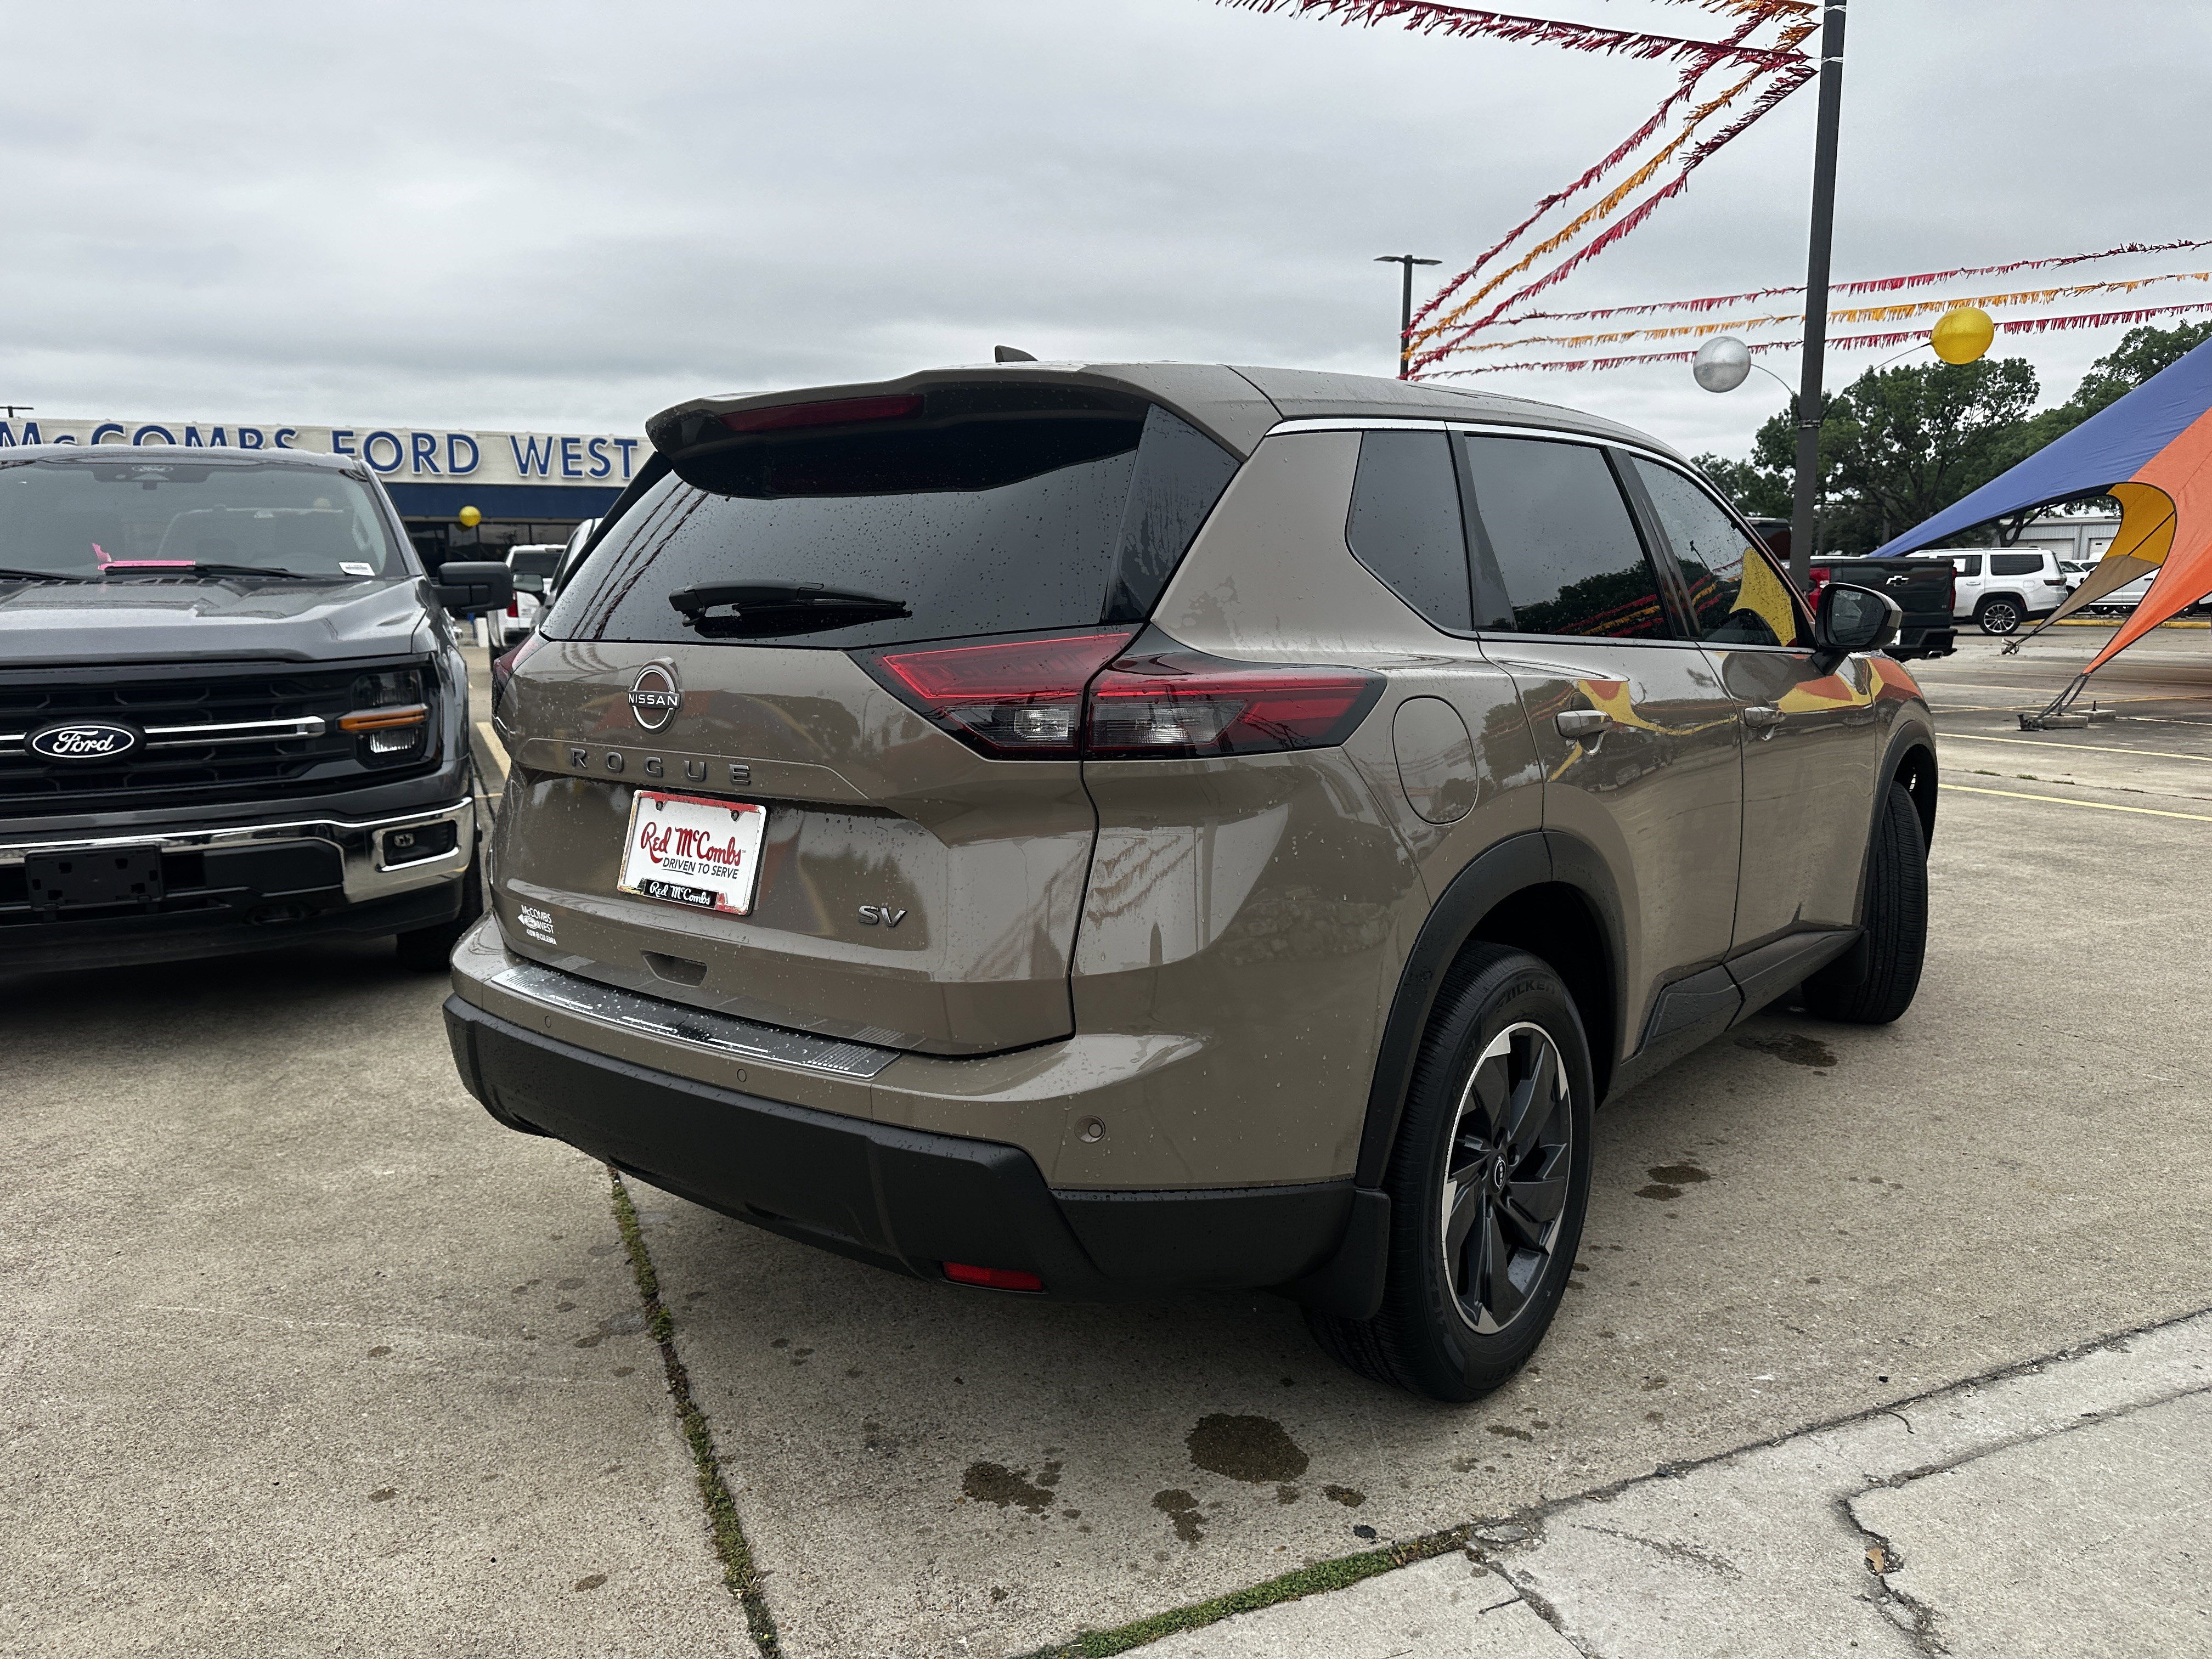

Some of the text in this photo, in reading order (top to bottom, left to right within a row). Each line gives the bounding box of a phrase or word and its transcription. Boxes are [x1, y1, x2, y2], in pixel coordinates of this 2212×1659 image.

[332, 431, 479, 473] FORD
[509, 435, 637, 479] WEST
[628, 692, 678, 707] NISSAN
[53, 730, 115, 753] Ford
[569, 748, 751, 786] ROGUE
[640, 821, 742, 866] Red McCombs
[662, 857, 739, 879] DRIVEN TO SERVE
[650, 881, 710, 905] Red McCombs
[537, 920, 554, 934] WEST
[859, 905, 907, 927] SV
